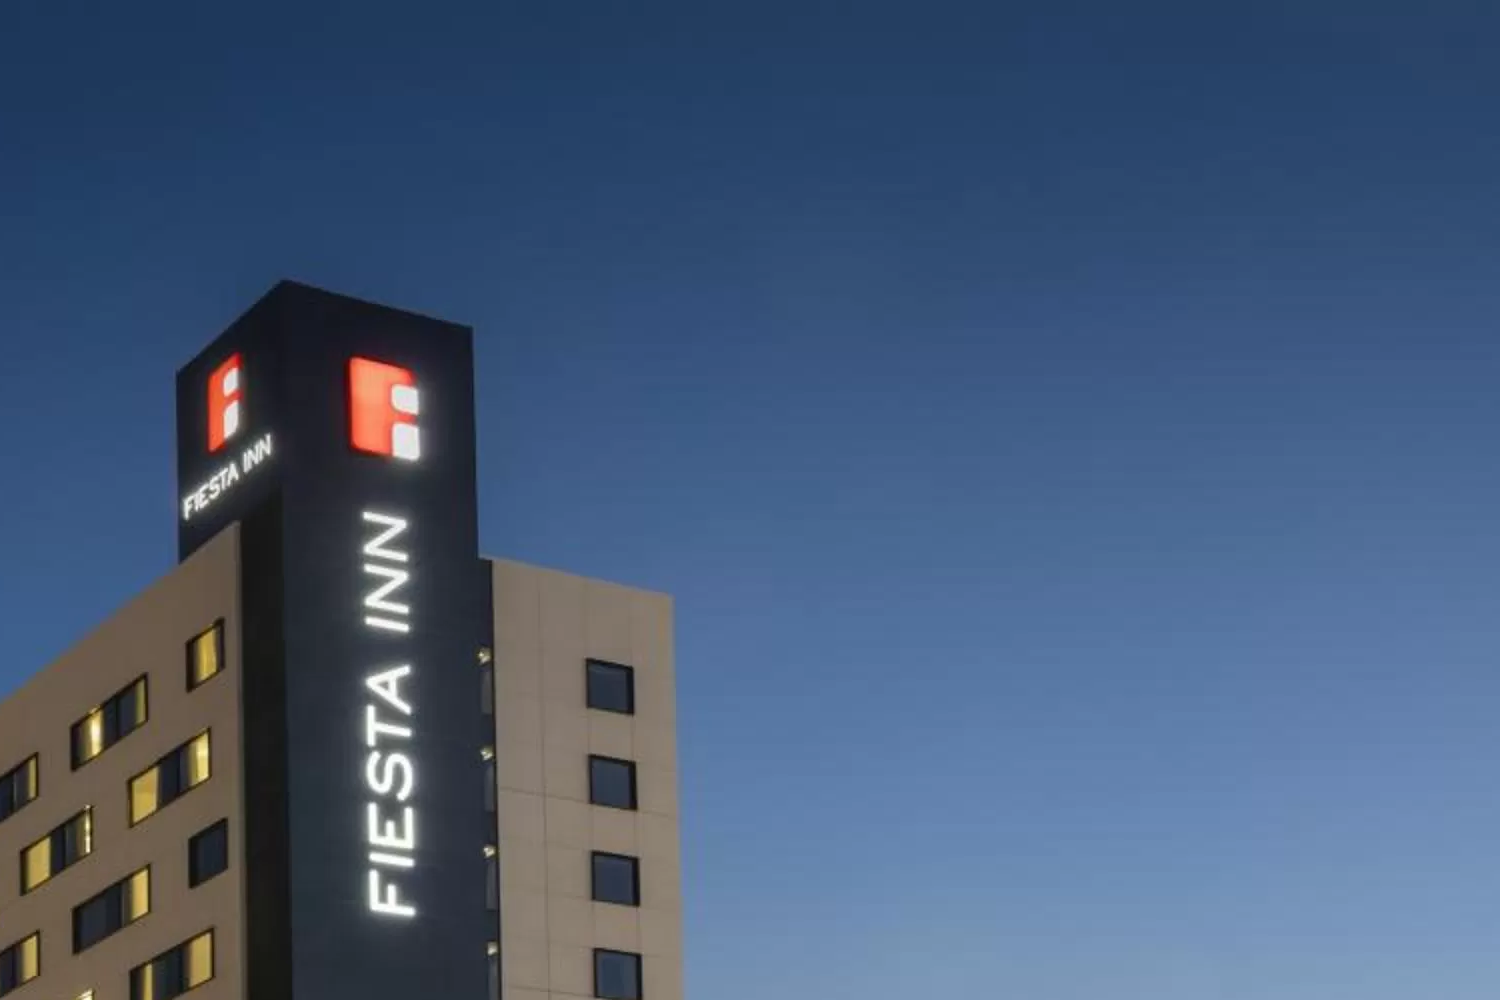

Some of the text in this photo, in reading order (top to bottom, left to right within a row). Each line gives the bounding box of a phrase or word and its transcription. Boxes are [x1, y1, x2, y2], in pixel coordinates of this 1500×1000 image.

[182, 433, 271, 520] FIESTA INN
[362, 511, 417, 918] FIESTA INN
